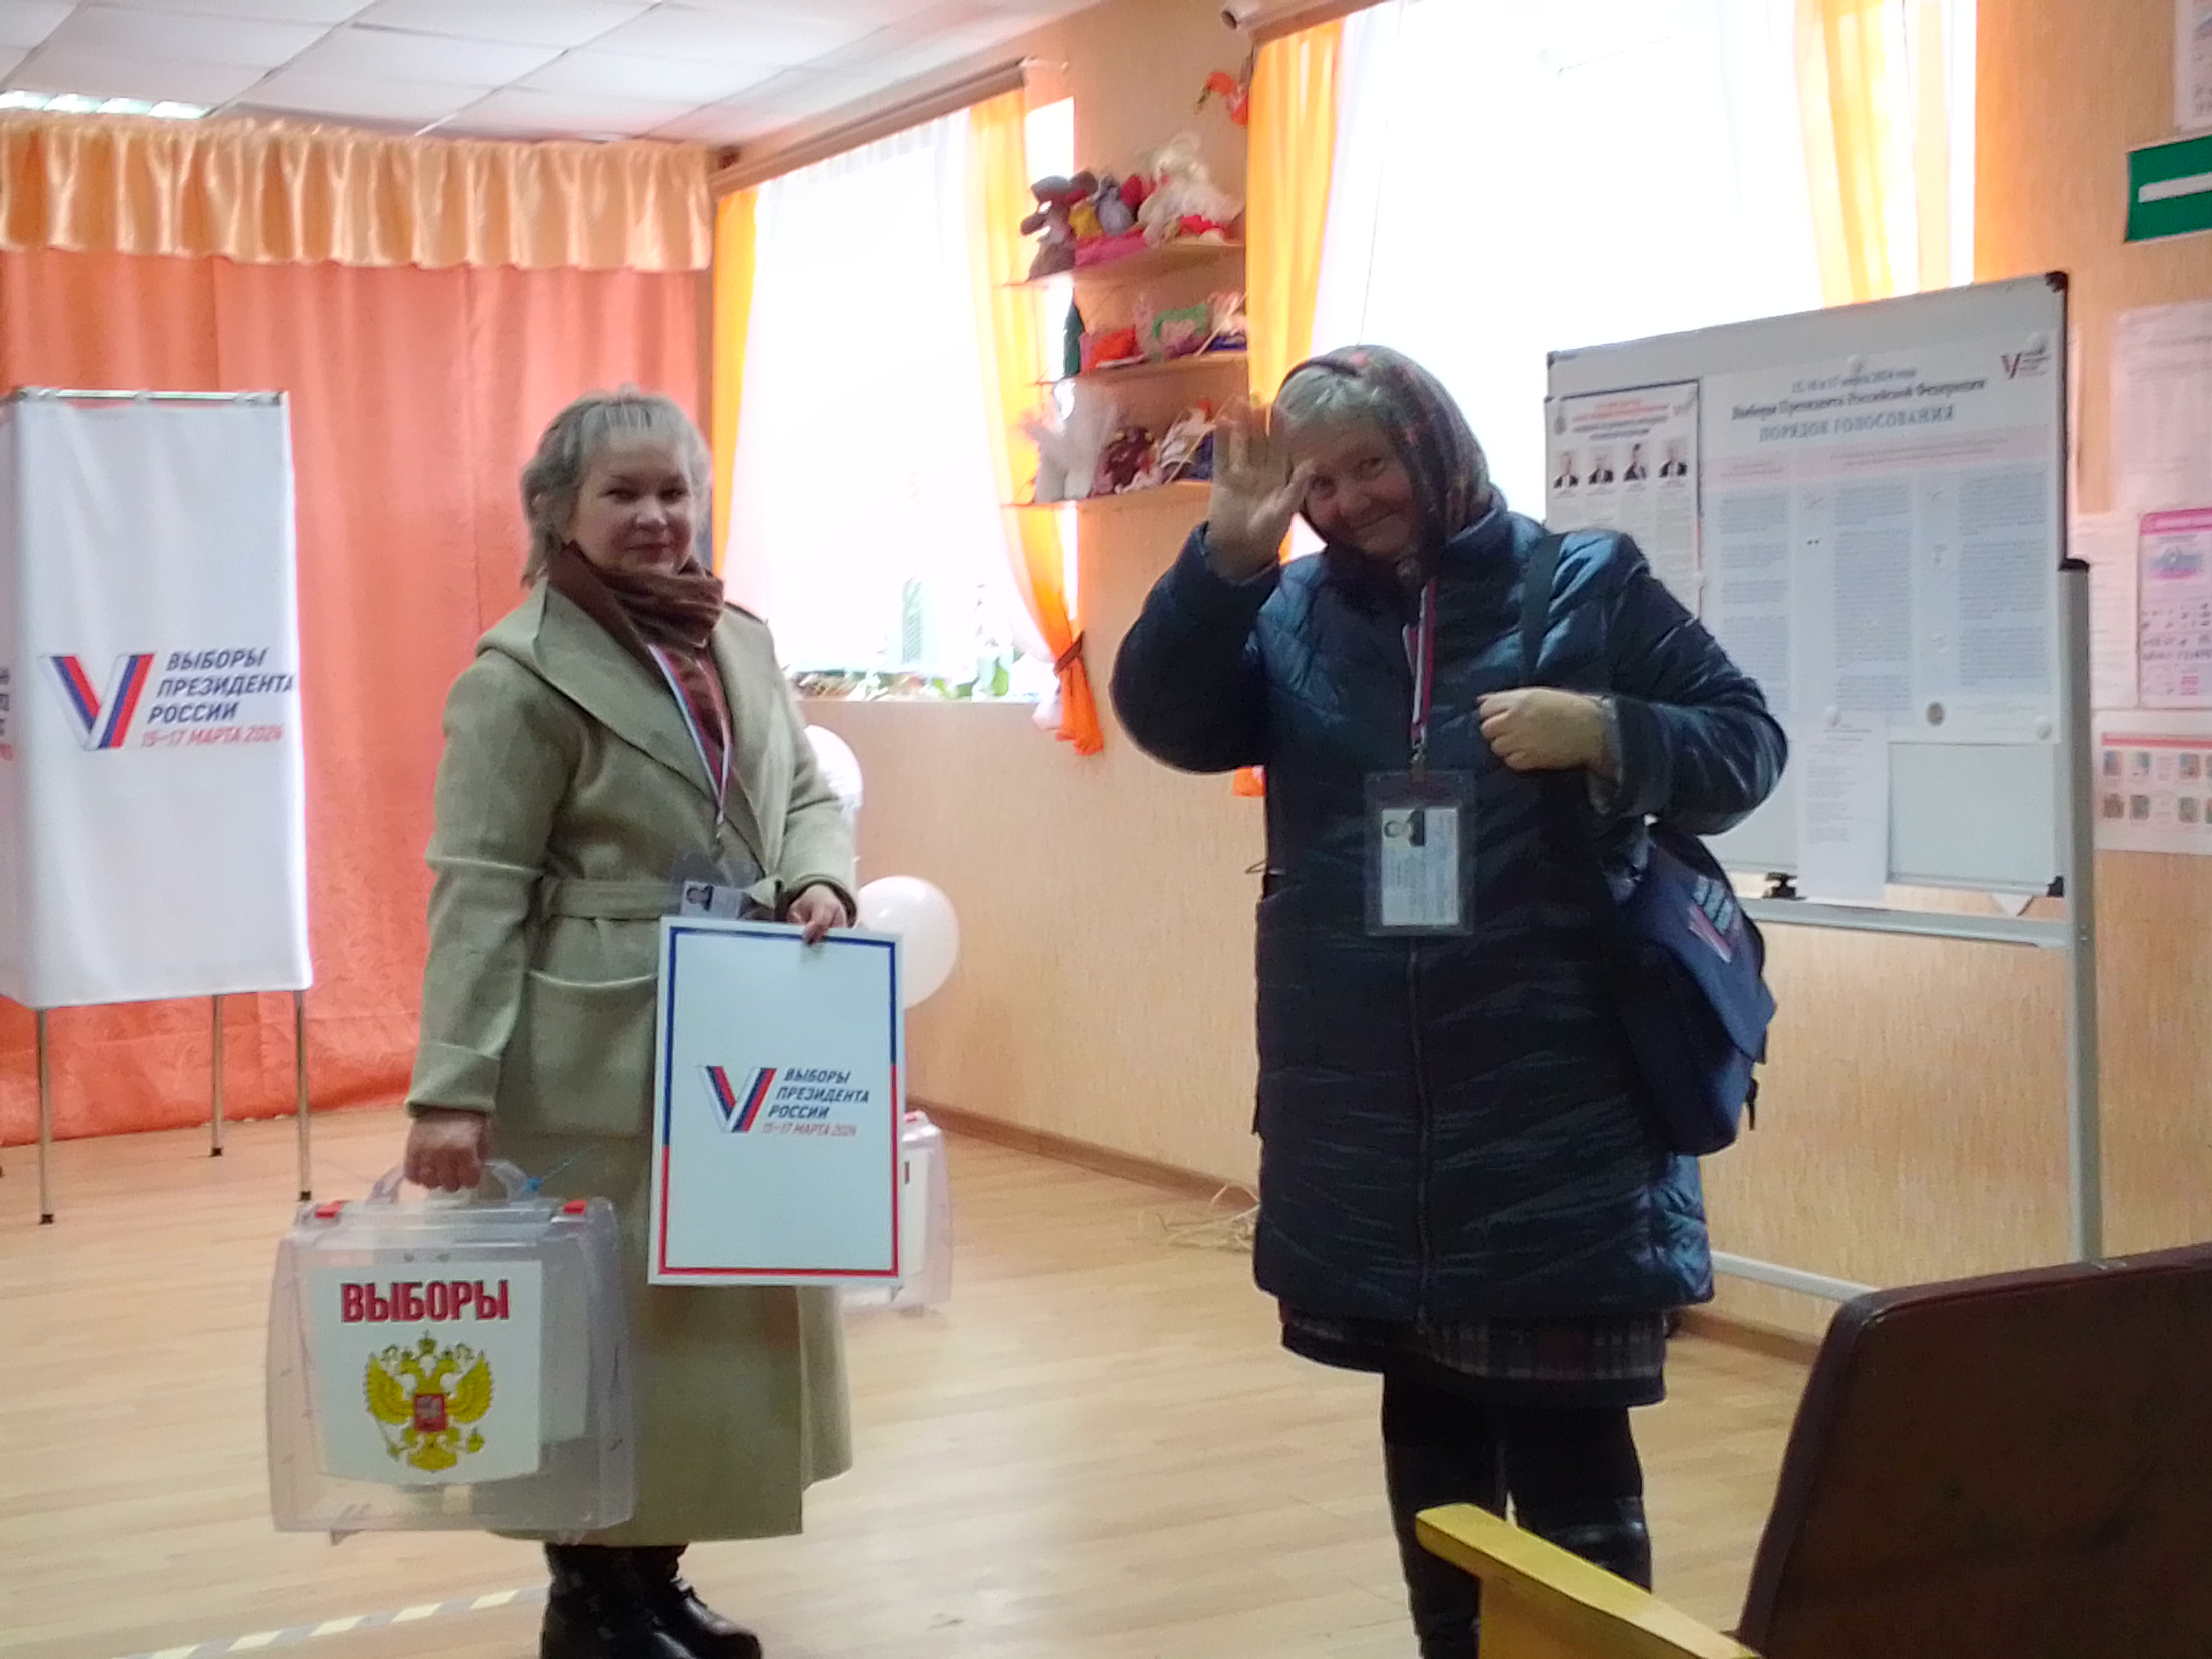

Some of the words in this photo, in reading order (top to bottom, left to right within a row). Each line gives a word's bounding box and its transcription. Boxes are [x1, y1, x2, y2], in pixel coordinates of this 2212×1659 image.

[167, 647, 269, 671] ВЫБОРЫ
[157, 674, 295, 697] ПРЕЗИДЕНТА
[147, 701, 239, 724] РОССИИ
[783, 1067, 851, 1084] ВЫБОРЫ
[776, 1086, 869, 1103] ПРЕЗИДЕНТА
[768, 1105, 830, 1119] РОССИИ
[341, 1279, 510, 1324] ВЫБОРЫ
